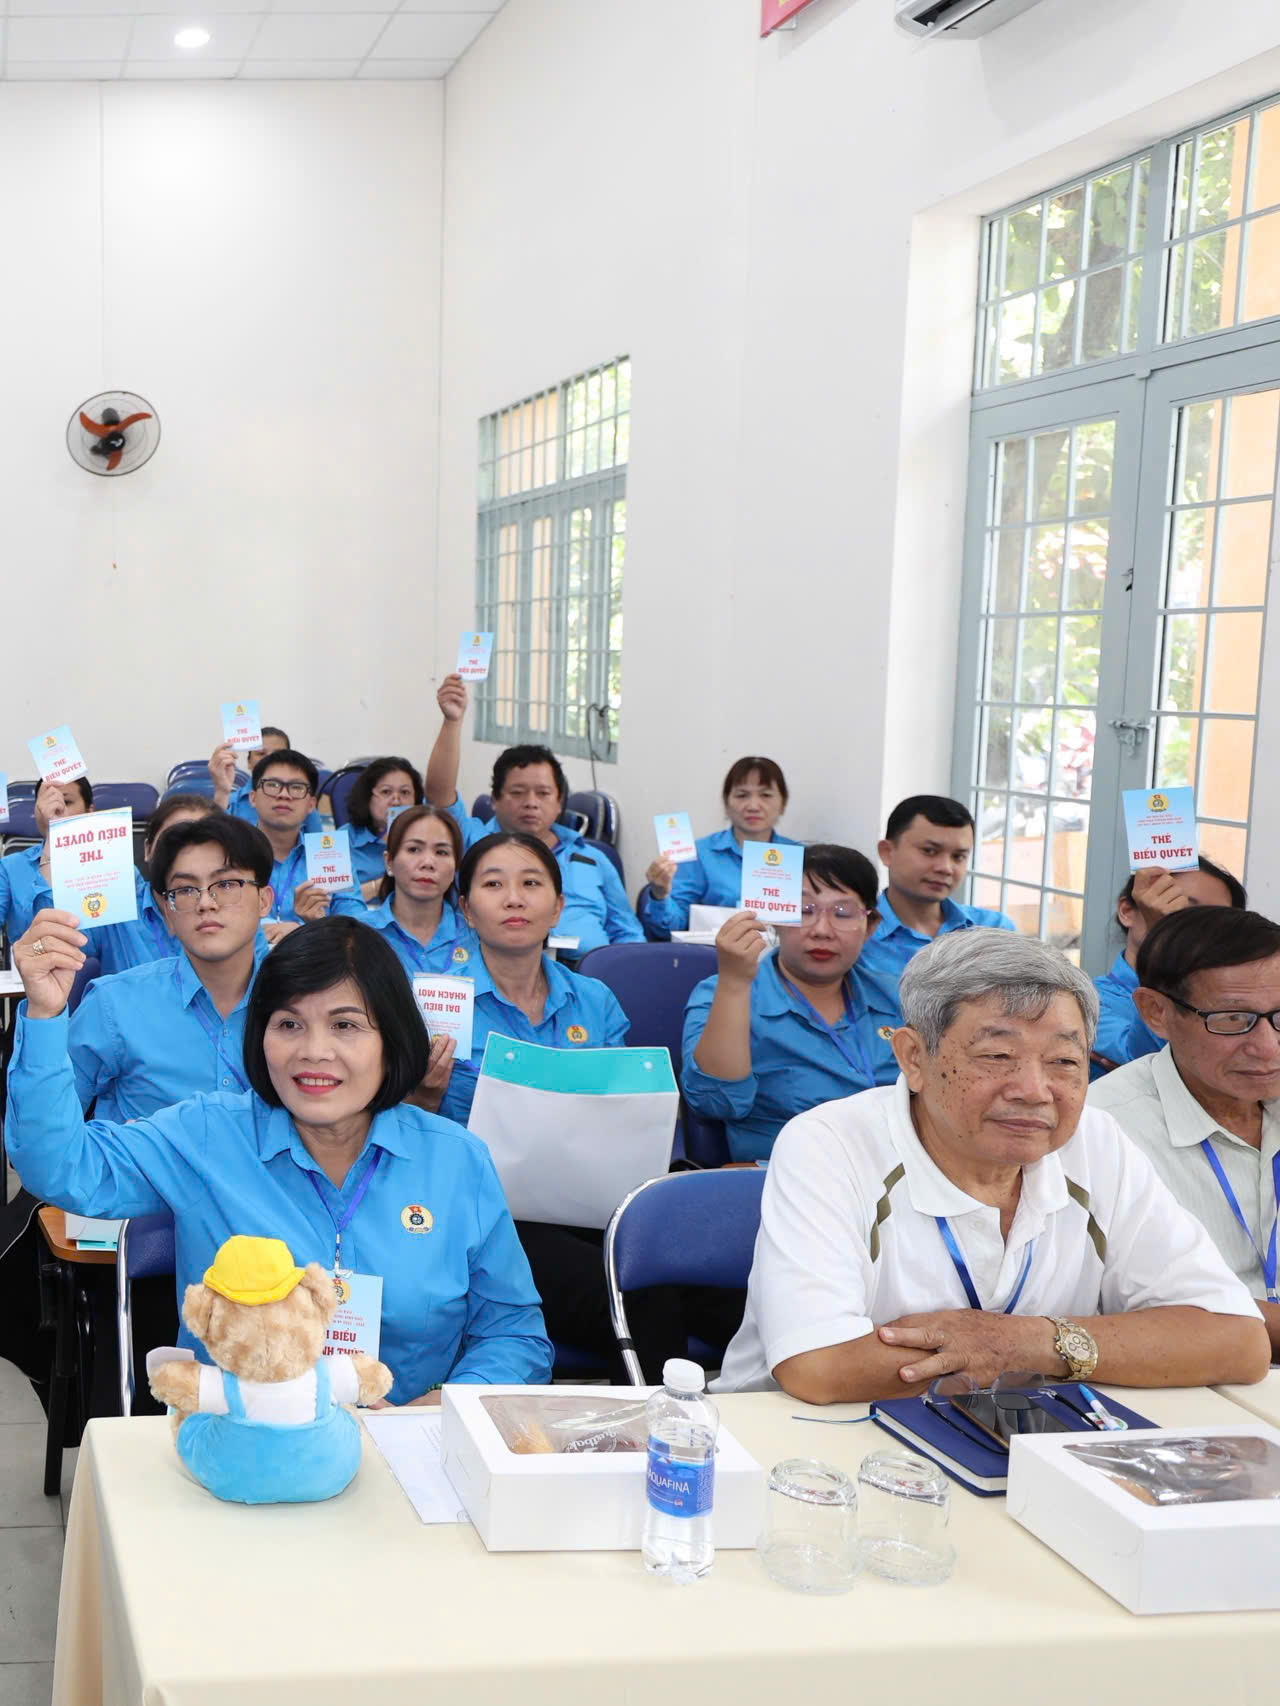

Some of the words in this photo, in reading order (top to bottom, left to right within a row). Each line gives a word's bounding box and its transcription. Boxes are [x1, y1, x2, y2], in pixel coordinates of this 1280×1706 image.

[1151, 832, 1172, 844] THẺ
[1133, 847, 1156, 860] BIỂU
[1160, 845, 1193, 859] QUYẾT
[332, 1328, 357, 1342] BIỂU
